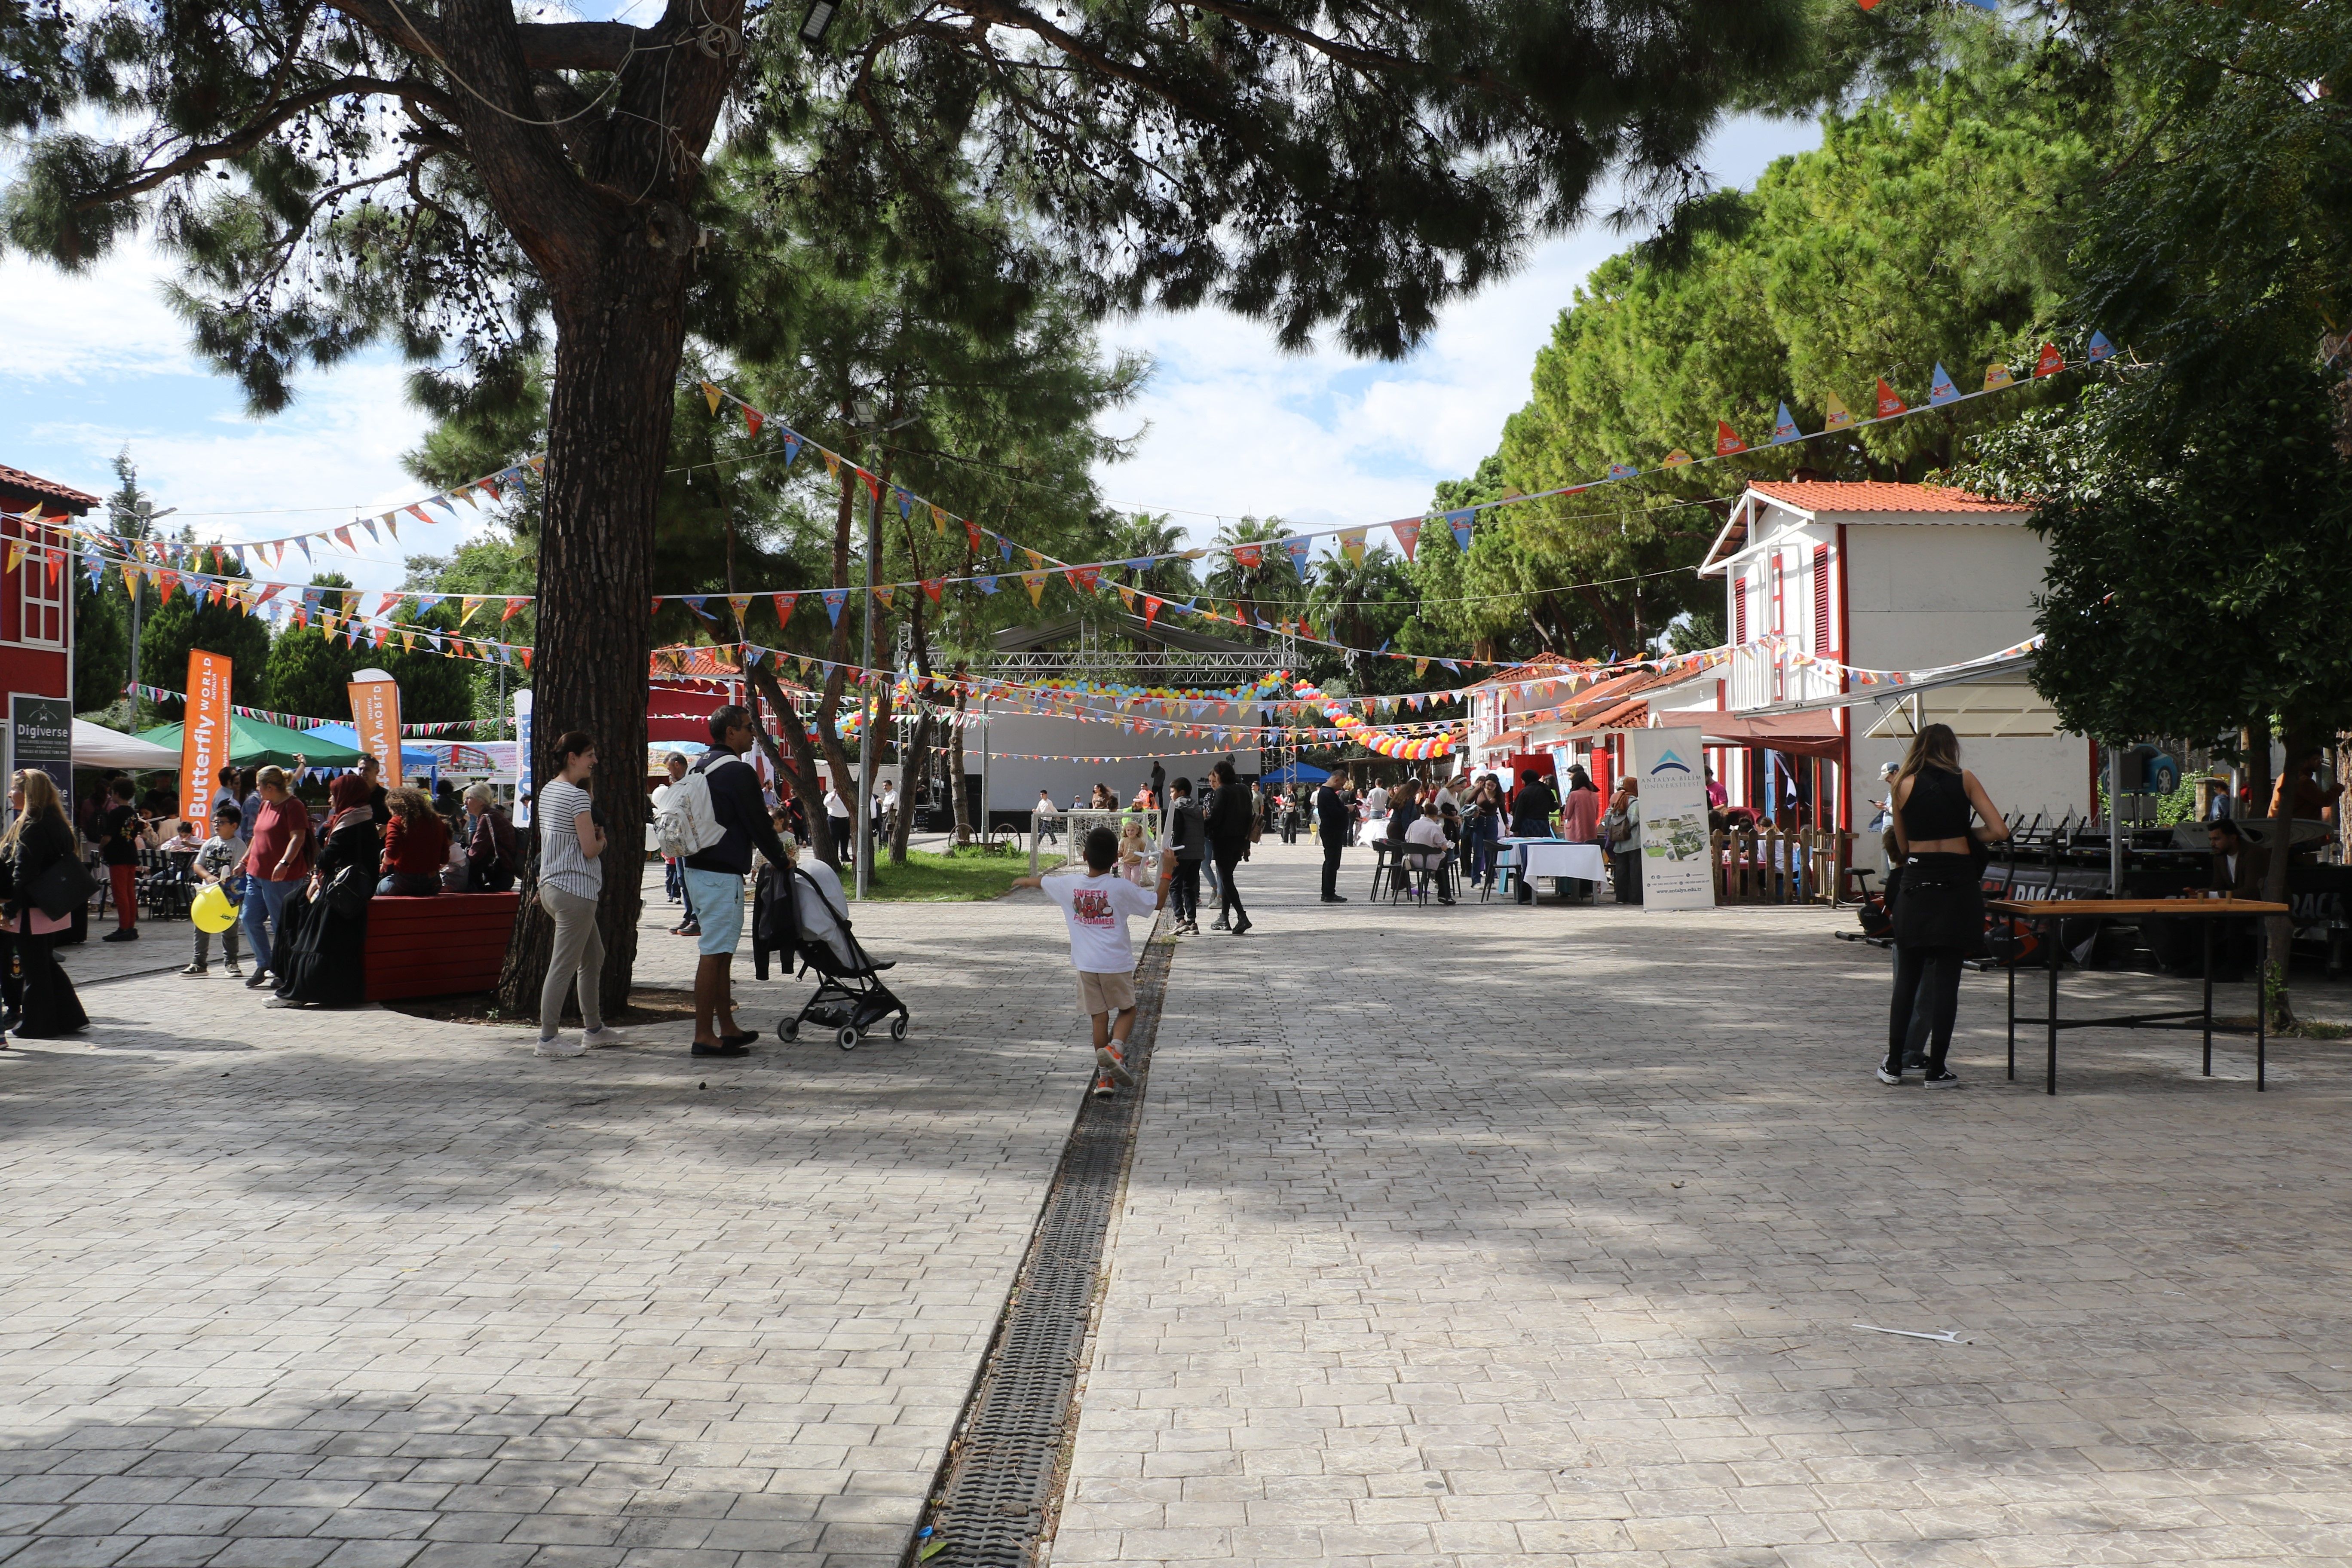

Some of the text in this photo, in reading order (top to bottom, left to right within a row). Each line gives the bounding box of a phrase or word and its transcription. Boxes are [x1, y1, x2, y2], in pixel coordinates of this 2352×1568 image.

[18, 724, 68, 739] Digiverse
[189, 657, 215, 817] Butterfly WORLD
[1645, 781, 1699, 790] ÜNİVERSİTESİ
[1073, 888, 1101, 899] SWEET
